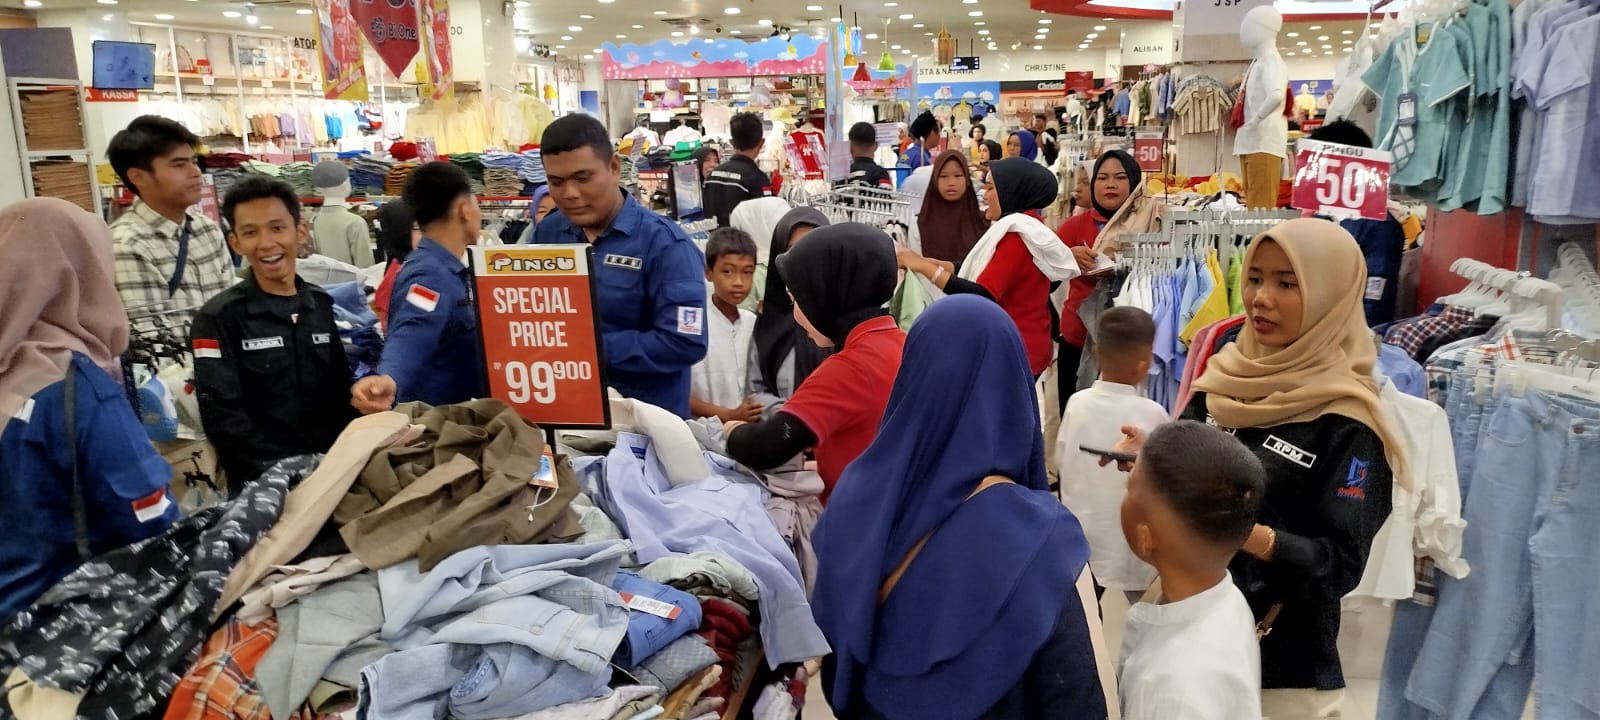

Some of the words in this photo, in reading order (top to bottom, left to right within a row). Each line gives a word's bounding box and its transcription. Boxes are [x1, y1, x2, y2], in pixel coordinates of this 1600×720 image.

[1024, 63, 1067, 72] CHRISTINE
[102, 89, 136, 100] KASSA
[1140, 145, 1159, 162] 50
[493, 256, 576, 272] PINGU
[492, 286, 577, 314] SPECIAL
[508, 320, 569, 348] PRICE
[1273, 440, 1303, 461] RPM
